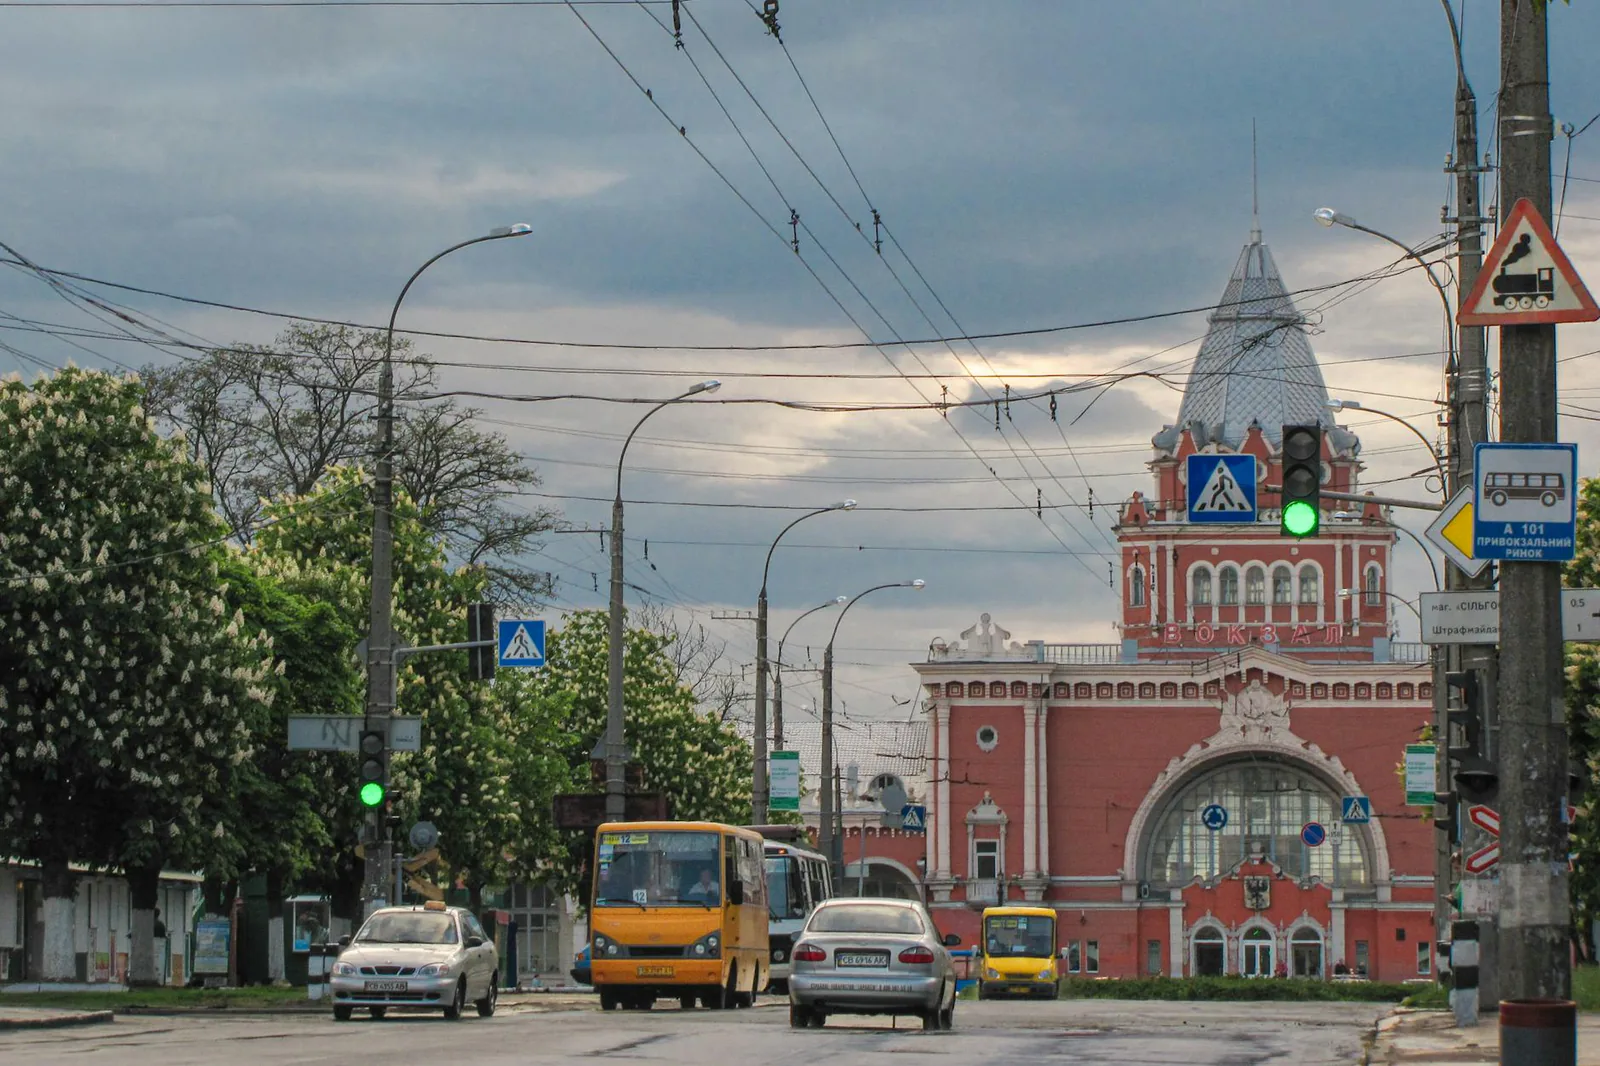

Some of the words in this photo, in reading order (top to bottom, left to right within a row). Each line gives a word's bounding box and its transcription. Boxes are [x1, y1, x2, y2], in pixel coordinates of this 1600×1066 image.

[1522, 523, 1545, 535] 101
[1476, 536, 1572, 548] ПРИВОКЗАЛЬНИЙ
[1505, 549, 1543, 558] РИНОК
[1456, 600, 1500, 611] «СІЛЬГО
[1164, 622, 1343, 645] ВОКЗАЛ
[1432, 624, 1500, 636] Штрафмайда
[621, 834, 631, 844] 12
[634, 891, 645, 902] 12
